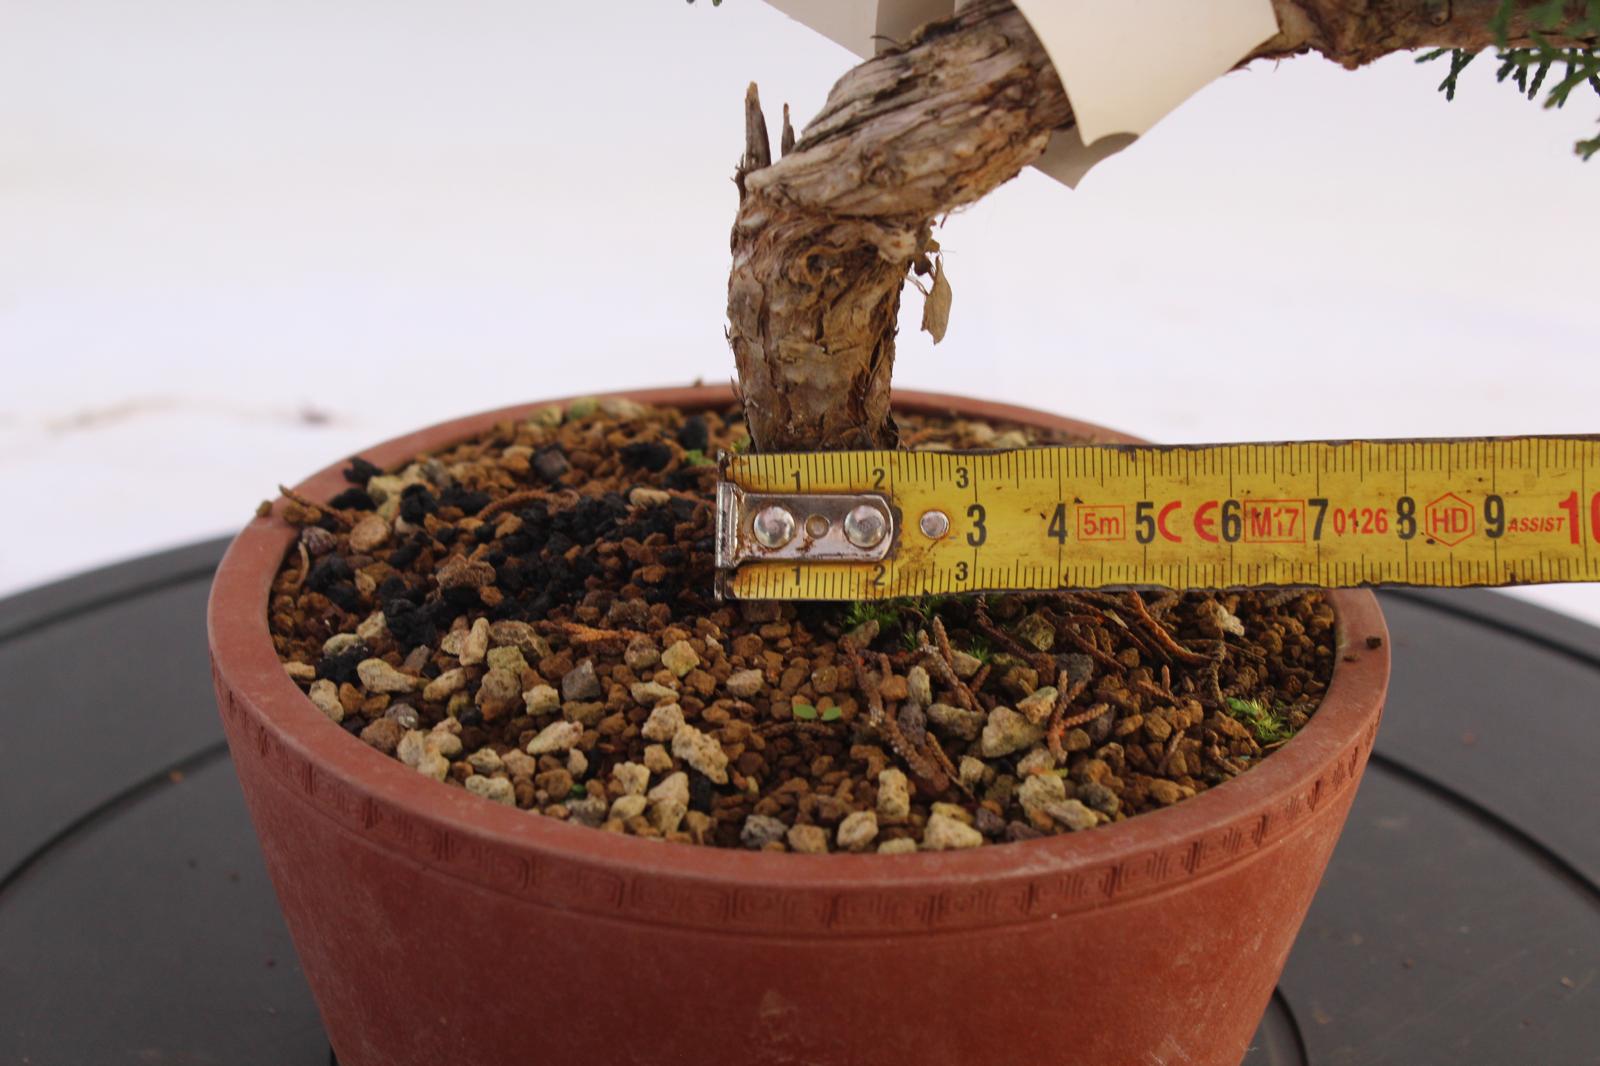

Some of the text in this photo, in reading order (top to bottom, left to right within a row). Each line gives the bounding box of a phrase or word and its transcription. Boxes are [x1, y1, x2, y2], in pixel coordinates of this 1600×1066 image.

[791, 467, 969, 490] 1 2 3
[966, 504, 986, 546] 3
[1048, 503, 1067, 544] 4
[1083, 513, 1120, 535] 5m
[1135, 502, 1155, 543] 5
[1221, 499, 1241, 542] 6
[1251, 508, 1299, 537] M17
[1308, 499, 1328, 540] 7
[1333, 508, 1388, 535] 0126
[1396, 496, 1416, 539] 8
[1432, 508, 1467, 533] HD
[1484, 495, 1504, 538] 9
[1507, 518, 1565, 532] ASSIST
[791, 562, 968, 586] 1 2 3
